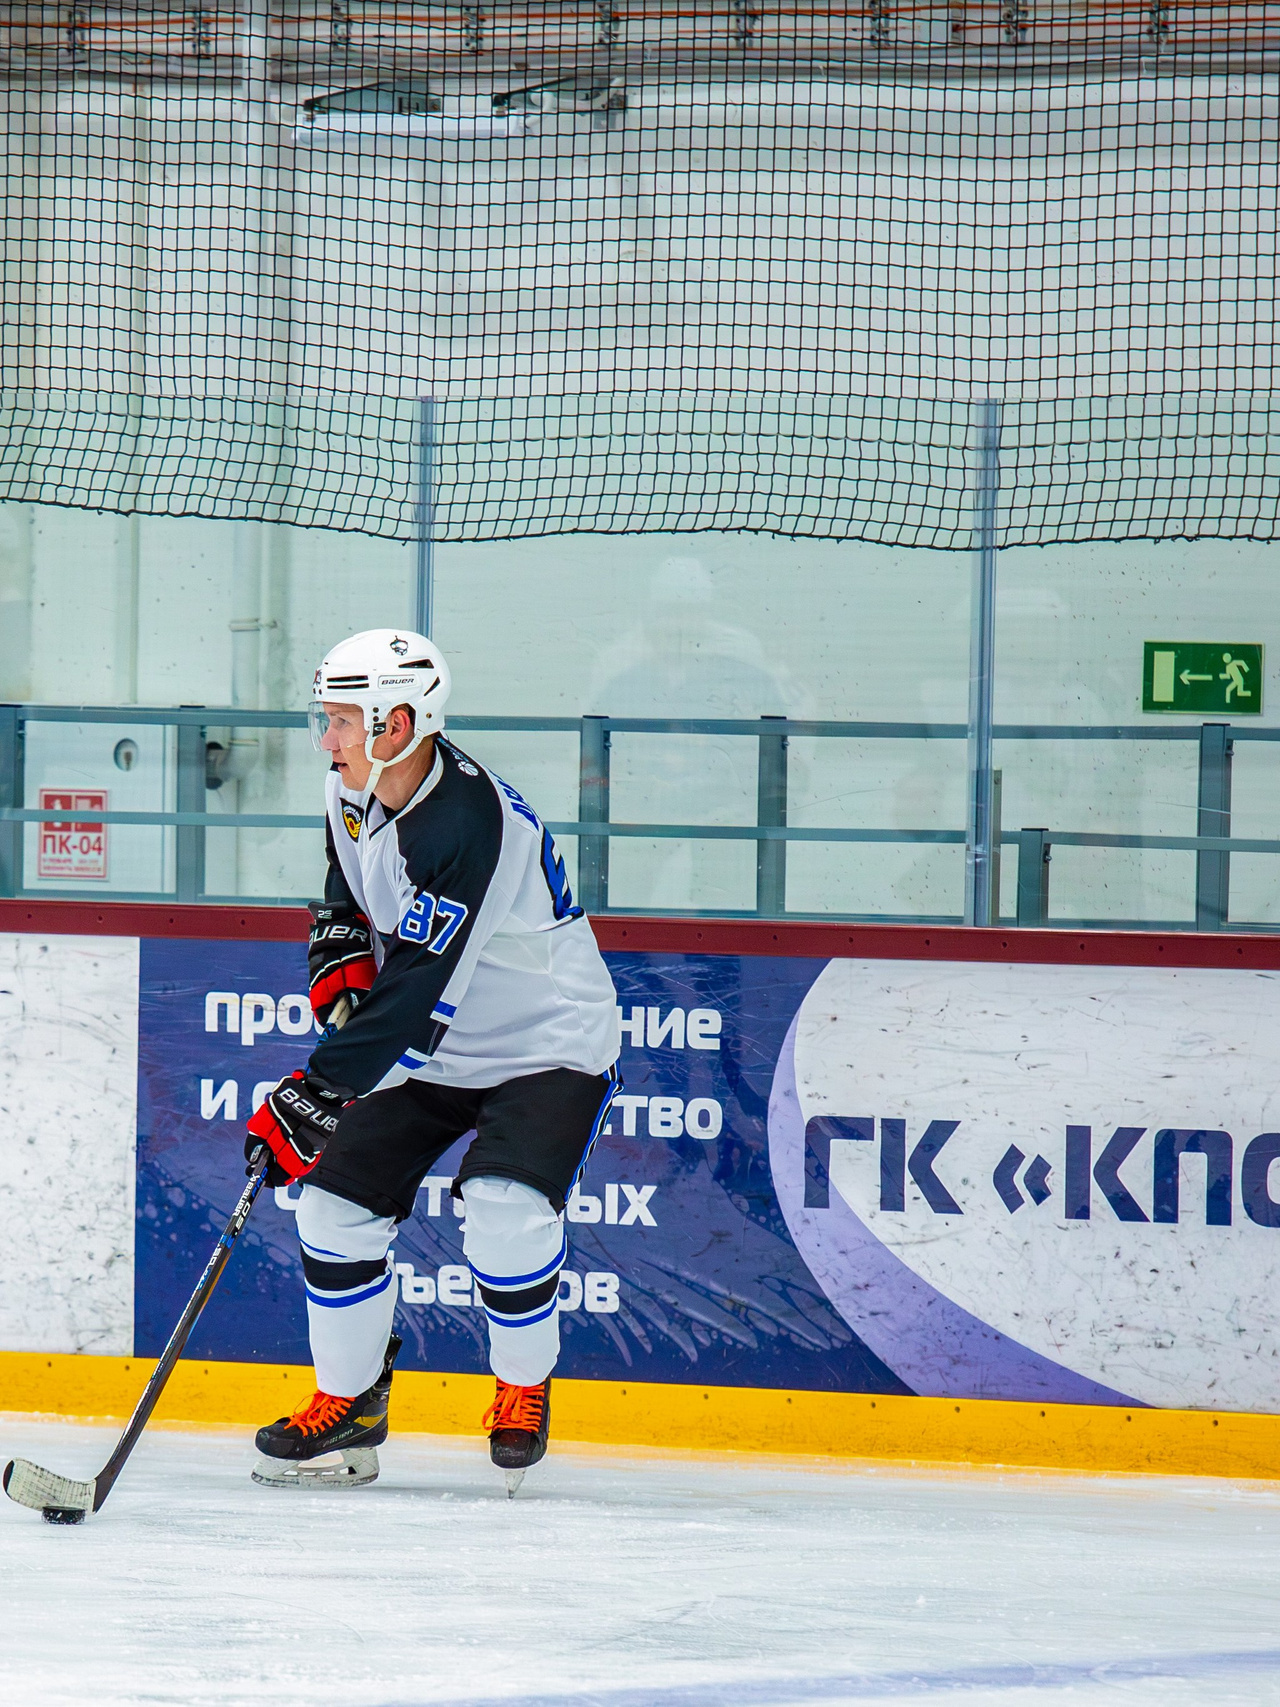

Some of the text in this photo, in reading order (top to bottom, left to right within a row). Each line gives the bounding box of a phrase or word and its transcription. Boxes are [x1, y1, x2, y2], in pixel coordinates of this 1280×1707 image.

[43, 834, 102, 855] ПК-04
[398, 888, 469, 955] 87
[278, 1087, 339, 1133] BAUE
[804, 1115, 964, 1215] ГК
